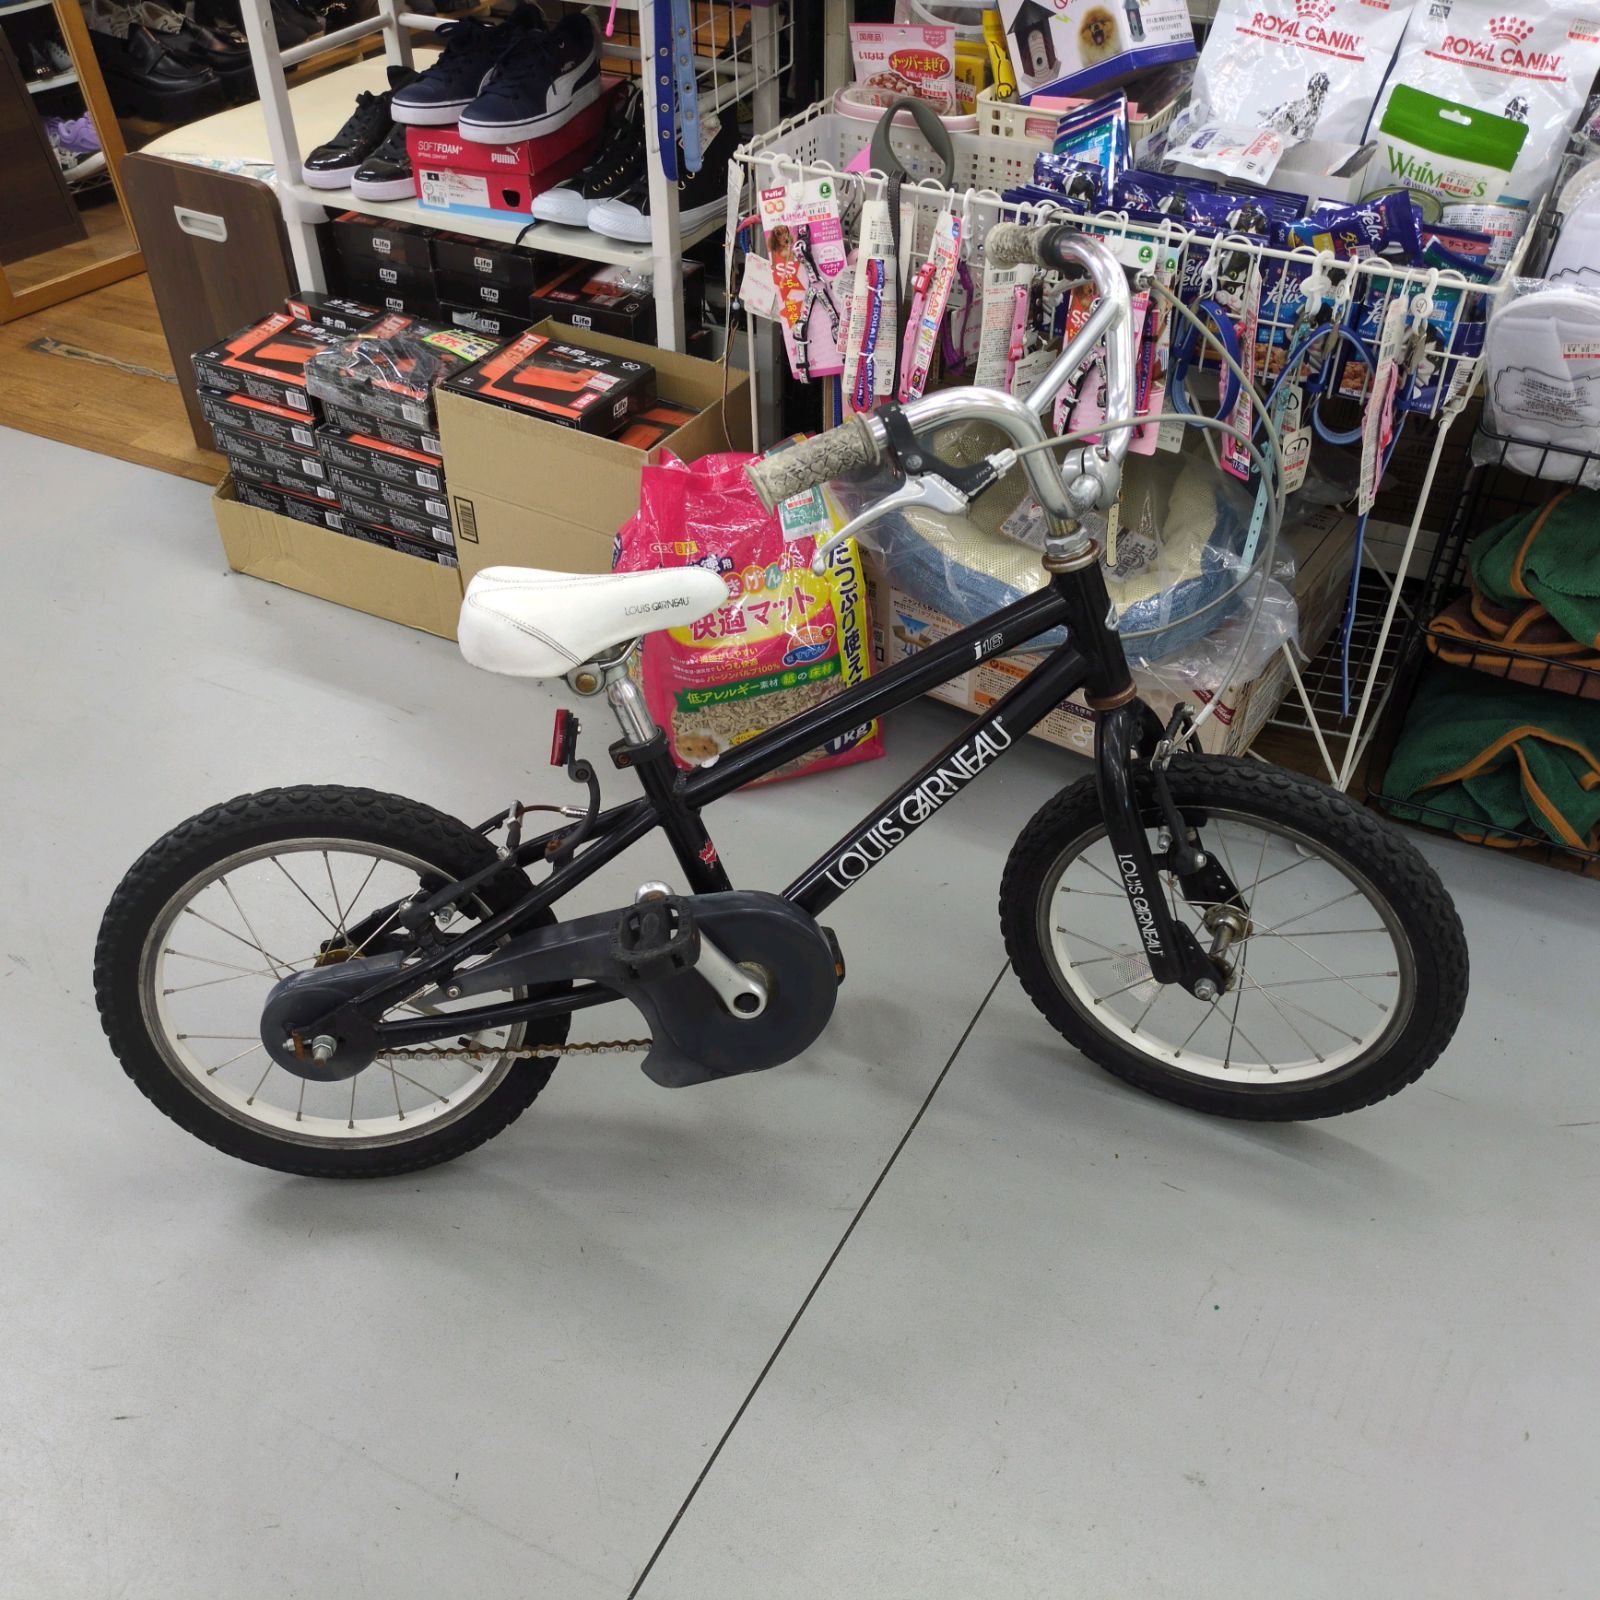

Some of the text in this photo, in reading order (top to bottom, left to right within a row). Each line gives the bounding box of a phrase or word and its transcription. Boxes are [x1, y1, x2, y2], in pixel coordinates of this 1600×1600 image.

[859, 32, 882, 41] 国産品
[1252, 12, 1360, 51] ROYAL CANIN
[859, 52, 885, 60] いなば
[1442, 36, 1561, 72] ROYAL CANIN
[491, 152, 518, 165] PUMA
[374, 238, 390, 249] Life
[1448, 240, 1477, 251] サーモン
[476, 257, 492, 268] Life
[381, 269, 396, 279] Life
[776, 261, 796, 276] SS
[482, 288, 498, 298] Life
[387, 298, 402, 307] Life
[483, 320, 499, 331] Life
[574, 315, 591, 326] Life
[614, 399, 628, 412] Life
[651, 543, 673, 554] GEX
[624, 597, 690, 616] LOUIS GARNEAU
[689, 586, 815, 641] 快適マット
[828, 541, 867, 685] たっぷり使え
[825, 719, 1012, 889] LOUIS GARNEAU
[1118, 854, 1164, 955] LOUIS GARNEAU
